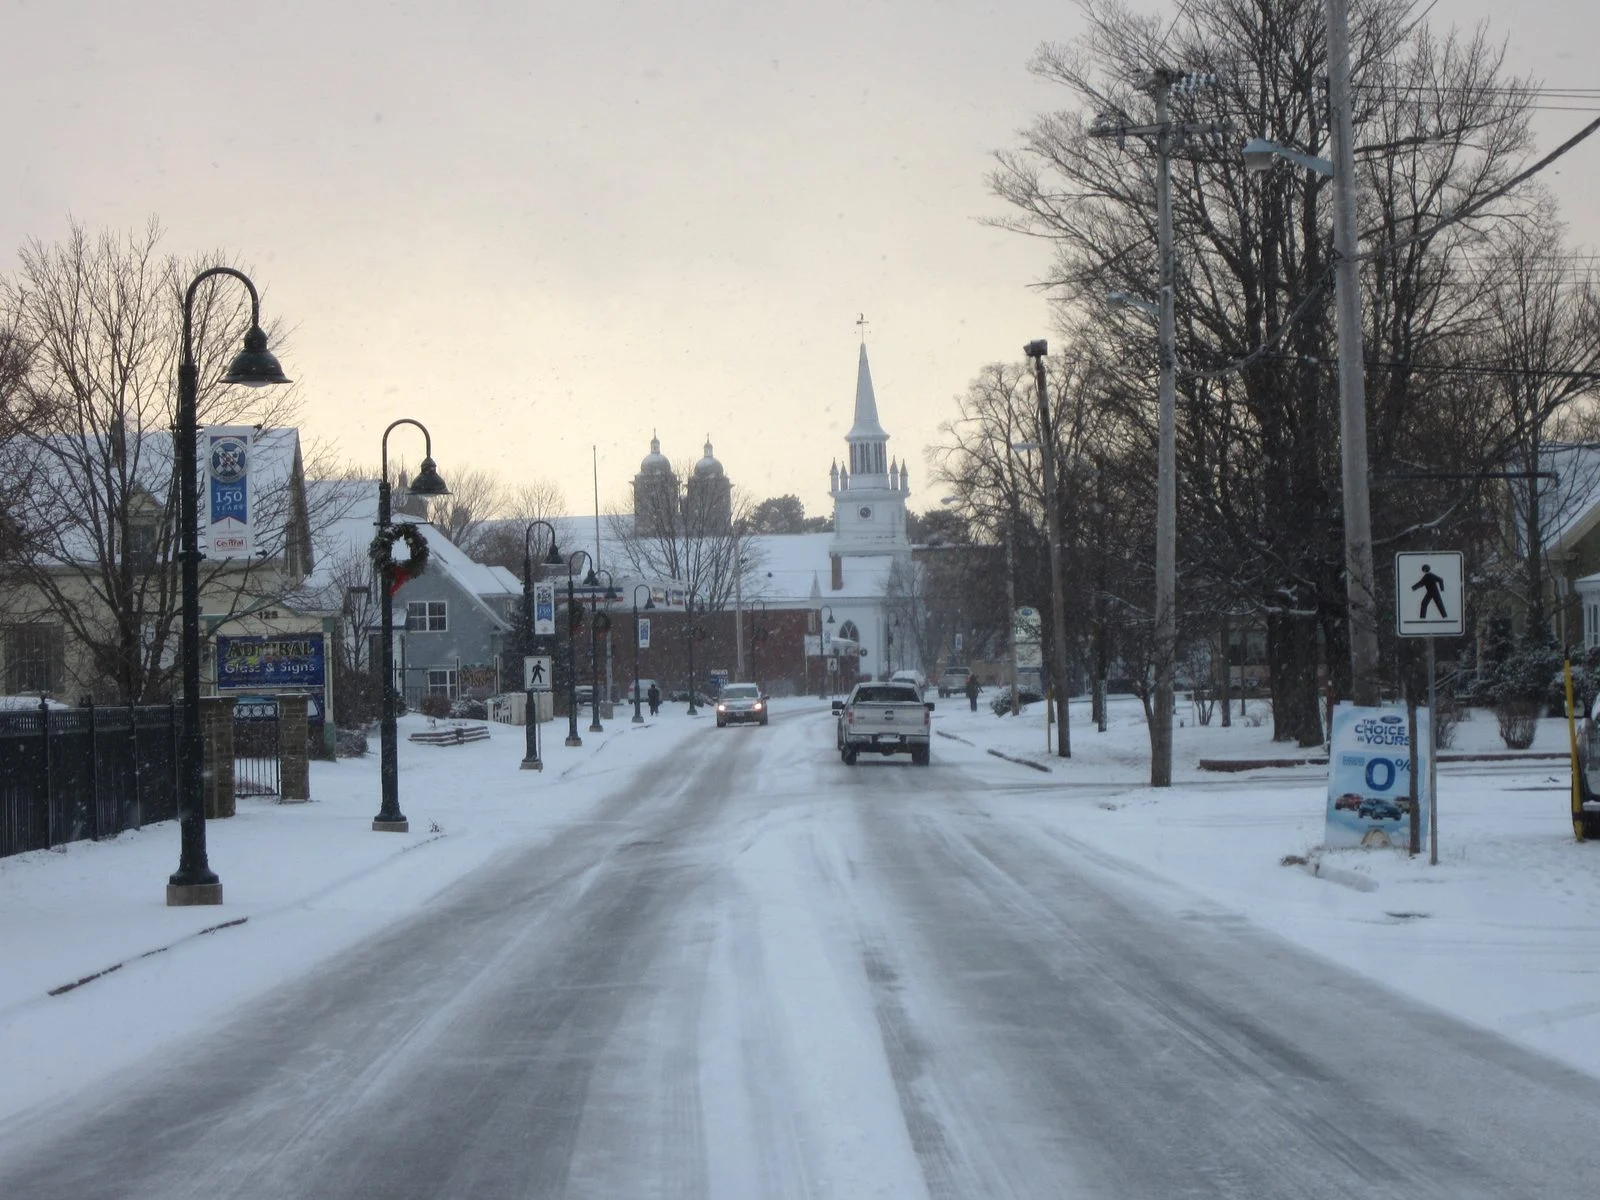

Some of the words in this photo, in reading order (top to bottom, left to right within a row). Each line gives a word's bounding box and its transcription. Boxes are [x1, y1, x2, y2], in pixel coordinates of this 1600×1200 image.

[216, 491, 242, 505] 150
[225, 663, 260, 673] Glass
[266, 663, 275, 673] &
[281, 662, 315, 674] Signs
[1355, 724, 1406, 736] CHOICE
[1365, 734, 1410, 746] YOURS
